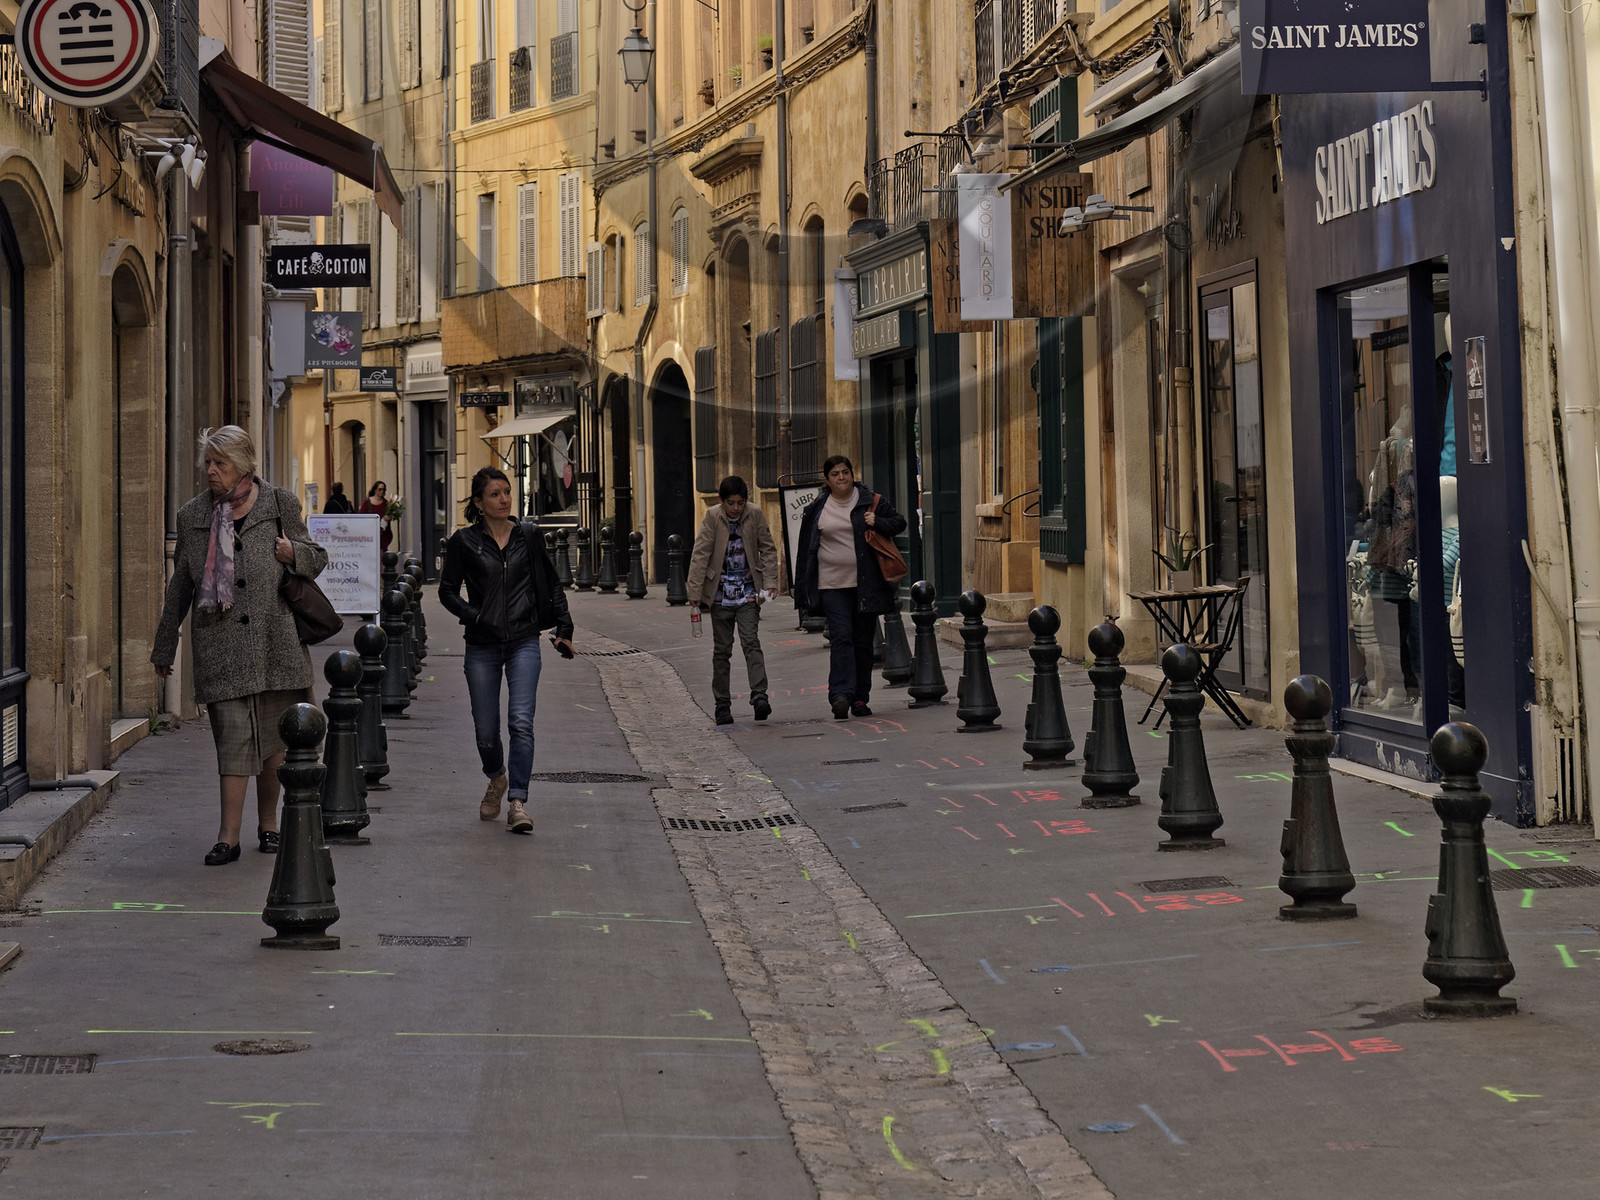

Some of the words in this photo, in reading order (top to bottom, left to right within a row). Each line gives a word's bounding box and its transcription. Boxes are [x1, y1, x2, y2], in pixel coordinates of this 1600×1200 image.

[1251, 24, 1329, 50] SAINT
[1315, 128, 1370, 225] SAINT
[1372, 100, 1436, 208] JAMES
[280, 194, 303, 208] Lili
[979, 199, 993, 295] GOULARD
[277, 256, 308, 275] CAFÉ
[326, 258, 366, 275] COTON
[860, 250, 926, 309] LIBRAIRIE
[854, 317, 899, 353] GOULARD
[327, 561, 359, 570] BOSS
